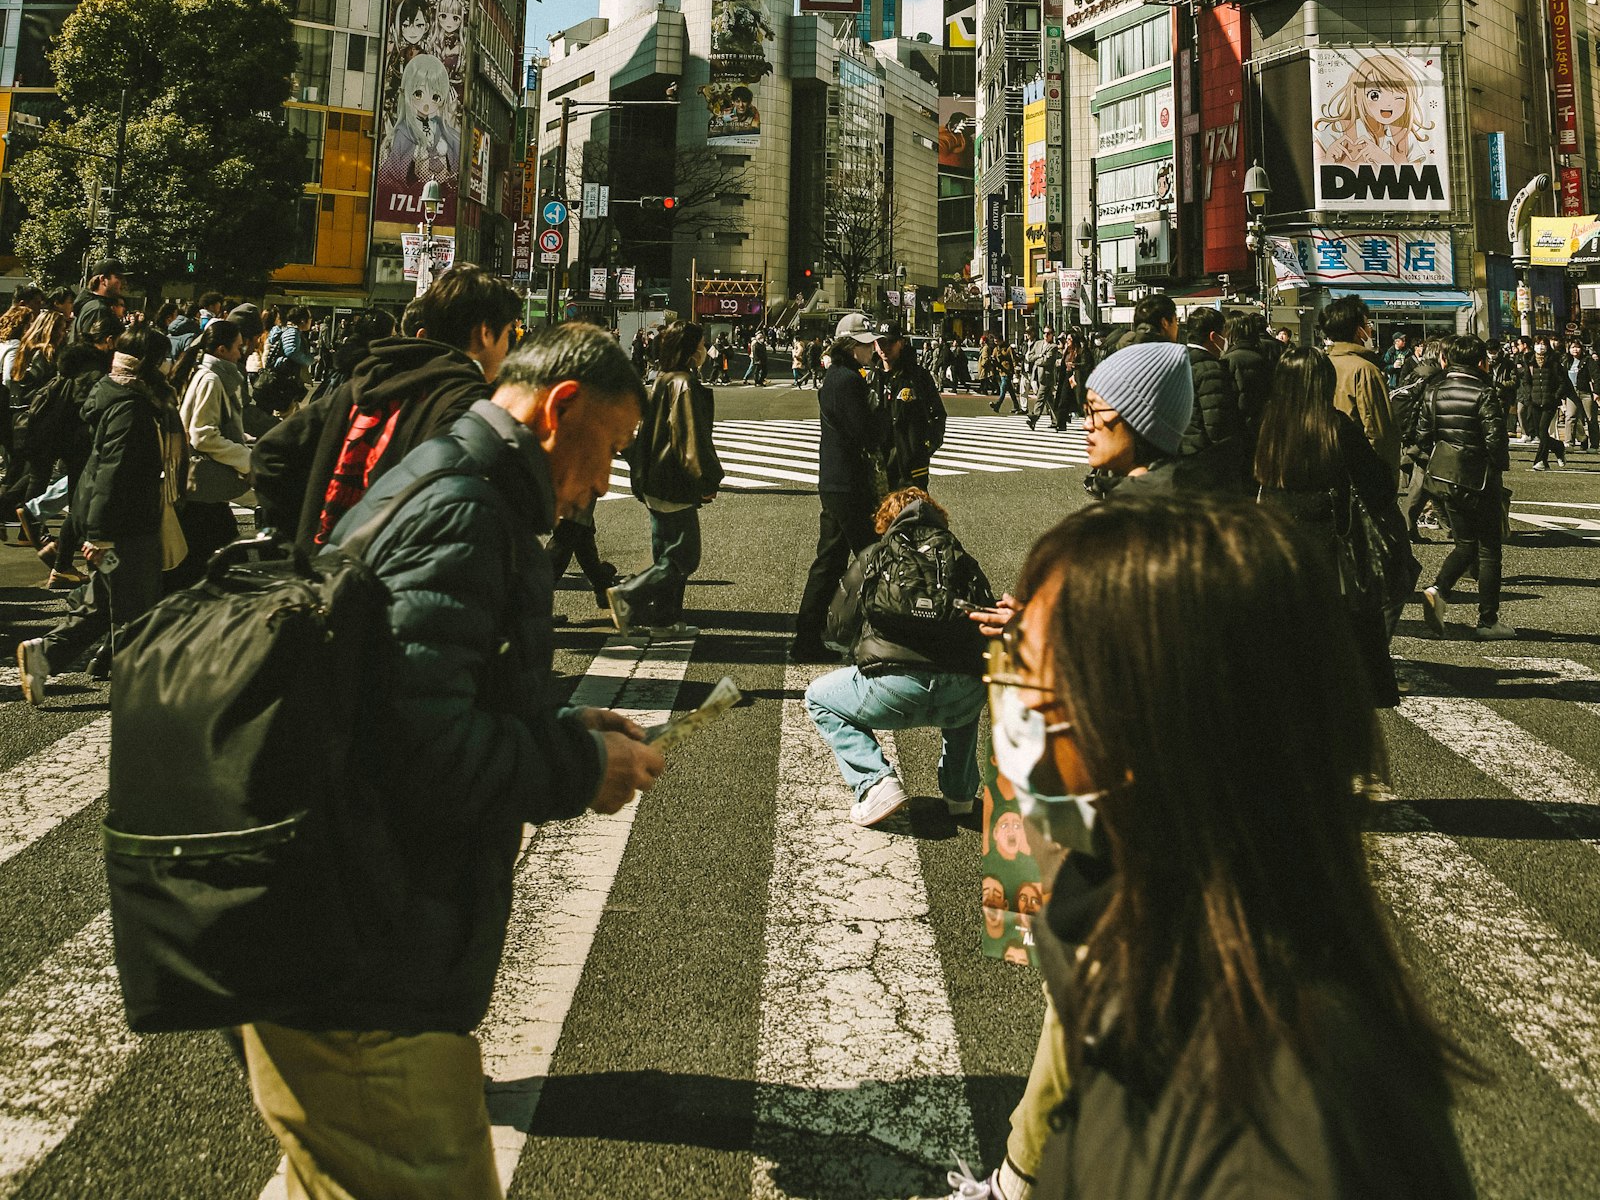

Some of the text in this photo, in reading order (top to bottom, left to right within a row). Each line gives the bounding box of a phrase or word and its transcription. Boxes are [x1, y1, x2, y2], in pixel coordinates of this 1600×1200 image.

[1556, 83, 1577, 146] 三千里
[1320, 164, 1445, 200] DMM
[517, 220, 530, 270] スギ薬局
[720, 299, 738, 313] 109
